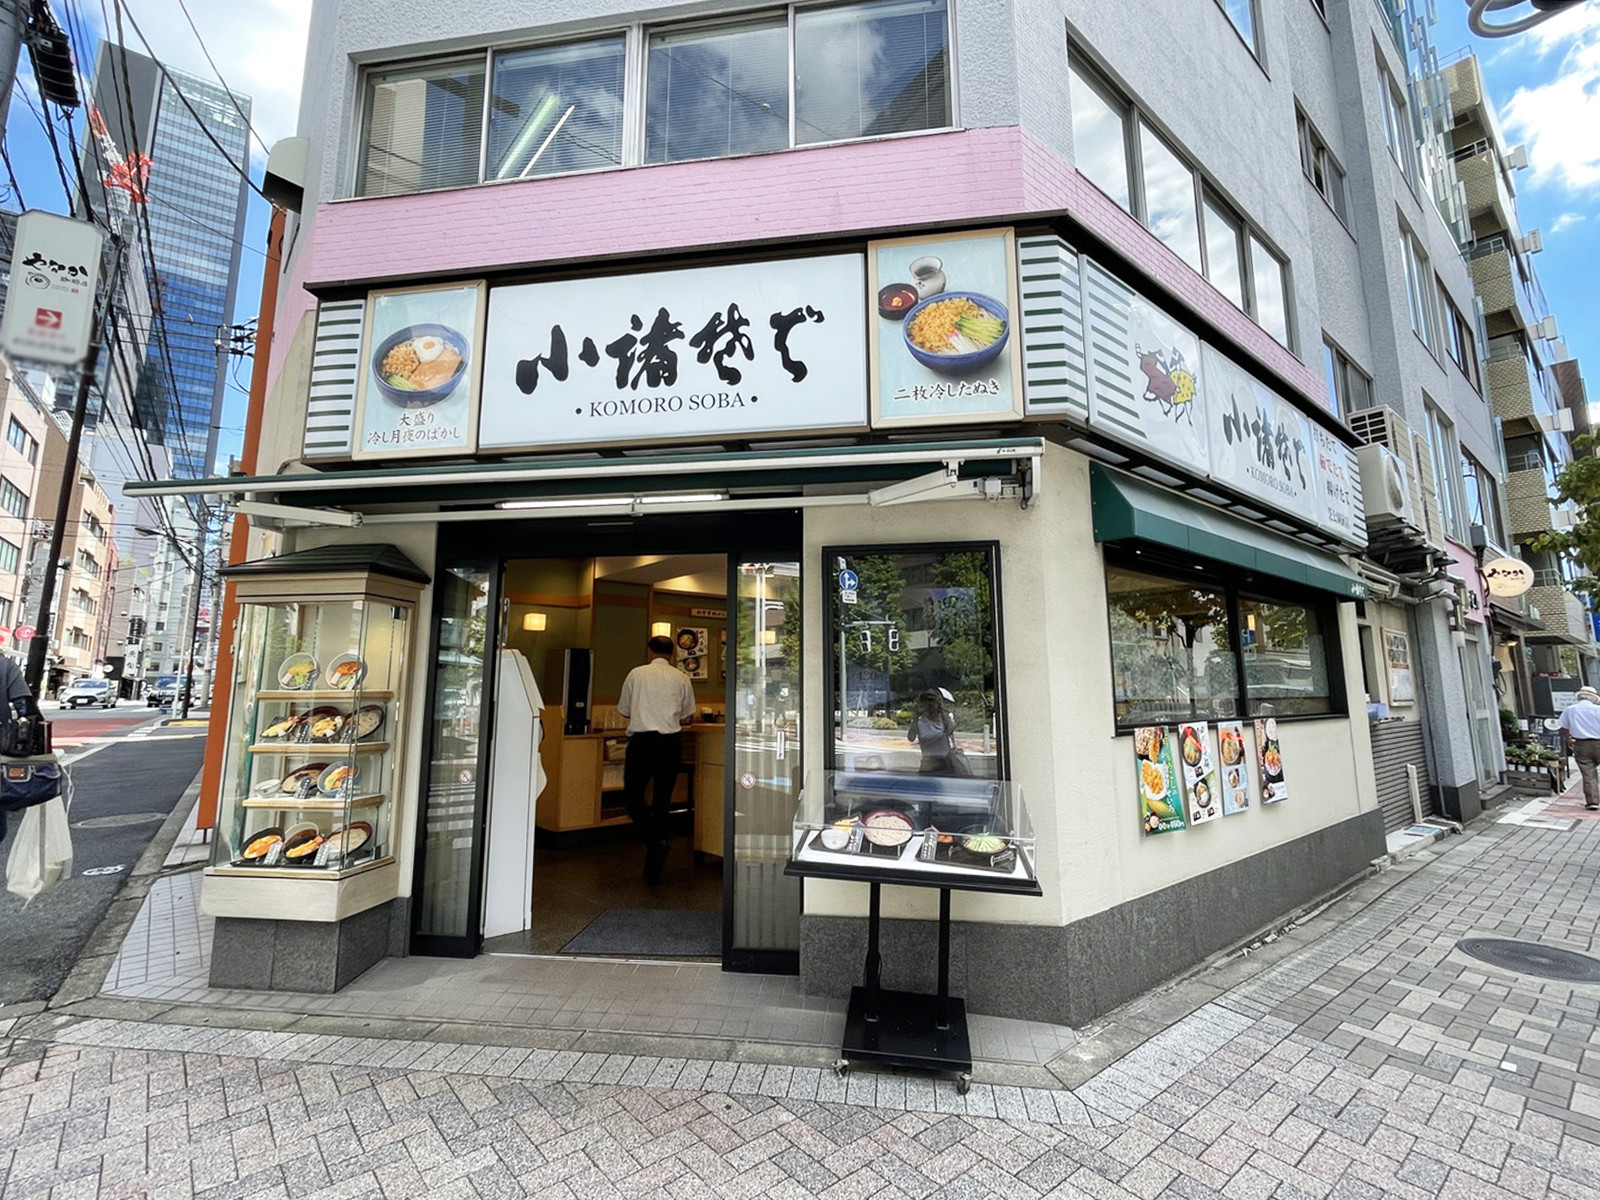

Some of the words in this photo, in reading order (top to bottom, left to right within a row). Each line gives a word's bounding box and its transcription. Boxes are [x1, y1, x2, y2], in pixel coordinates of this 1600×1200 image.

[894, 380, 999, 400] 二枚冷したぬき
[589, 396, 683, 417] KOMORO
[688, 392, 745, 410] SOBA
[399, 411, 434, 426] 大盛り
[367, 427, 460, 445] 冷し月夜のばかし
[1250, 466, 1279, 490] KOMORO
[1279, 480, 1295, 498] SOBA
